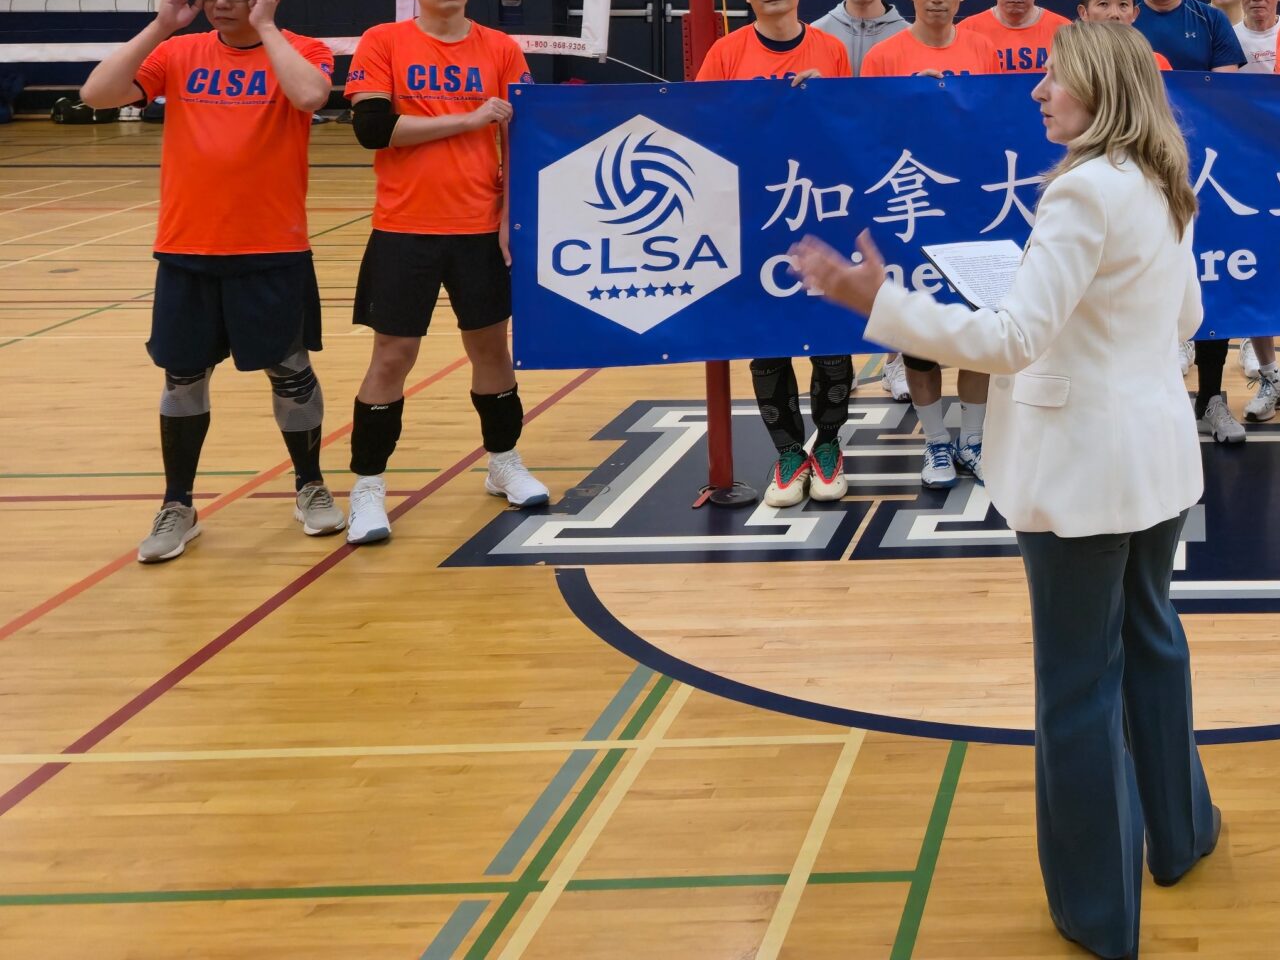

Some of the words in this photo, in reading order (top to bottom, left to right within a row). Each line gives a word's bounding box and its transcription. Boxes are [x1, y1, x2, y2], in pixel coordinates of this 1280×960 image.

[186, 68, 267, 96] CLSA
[407, 64, 483, 92] CLSA
[551, 234, 729, 277] CLSA
